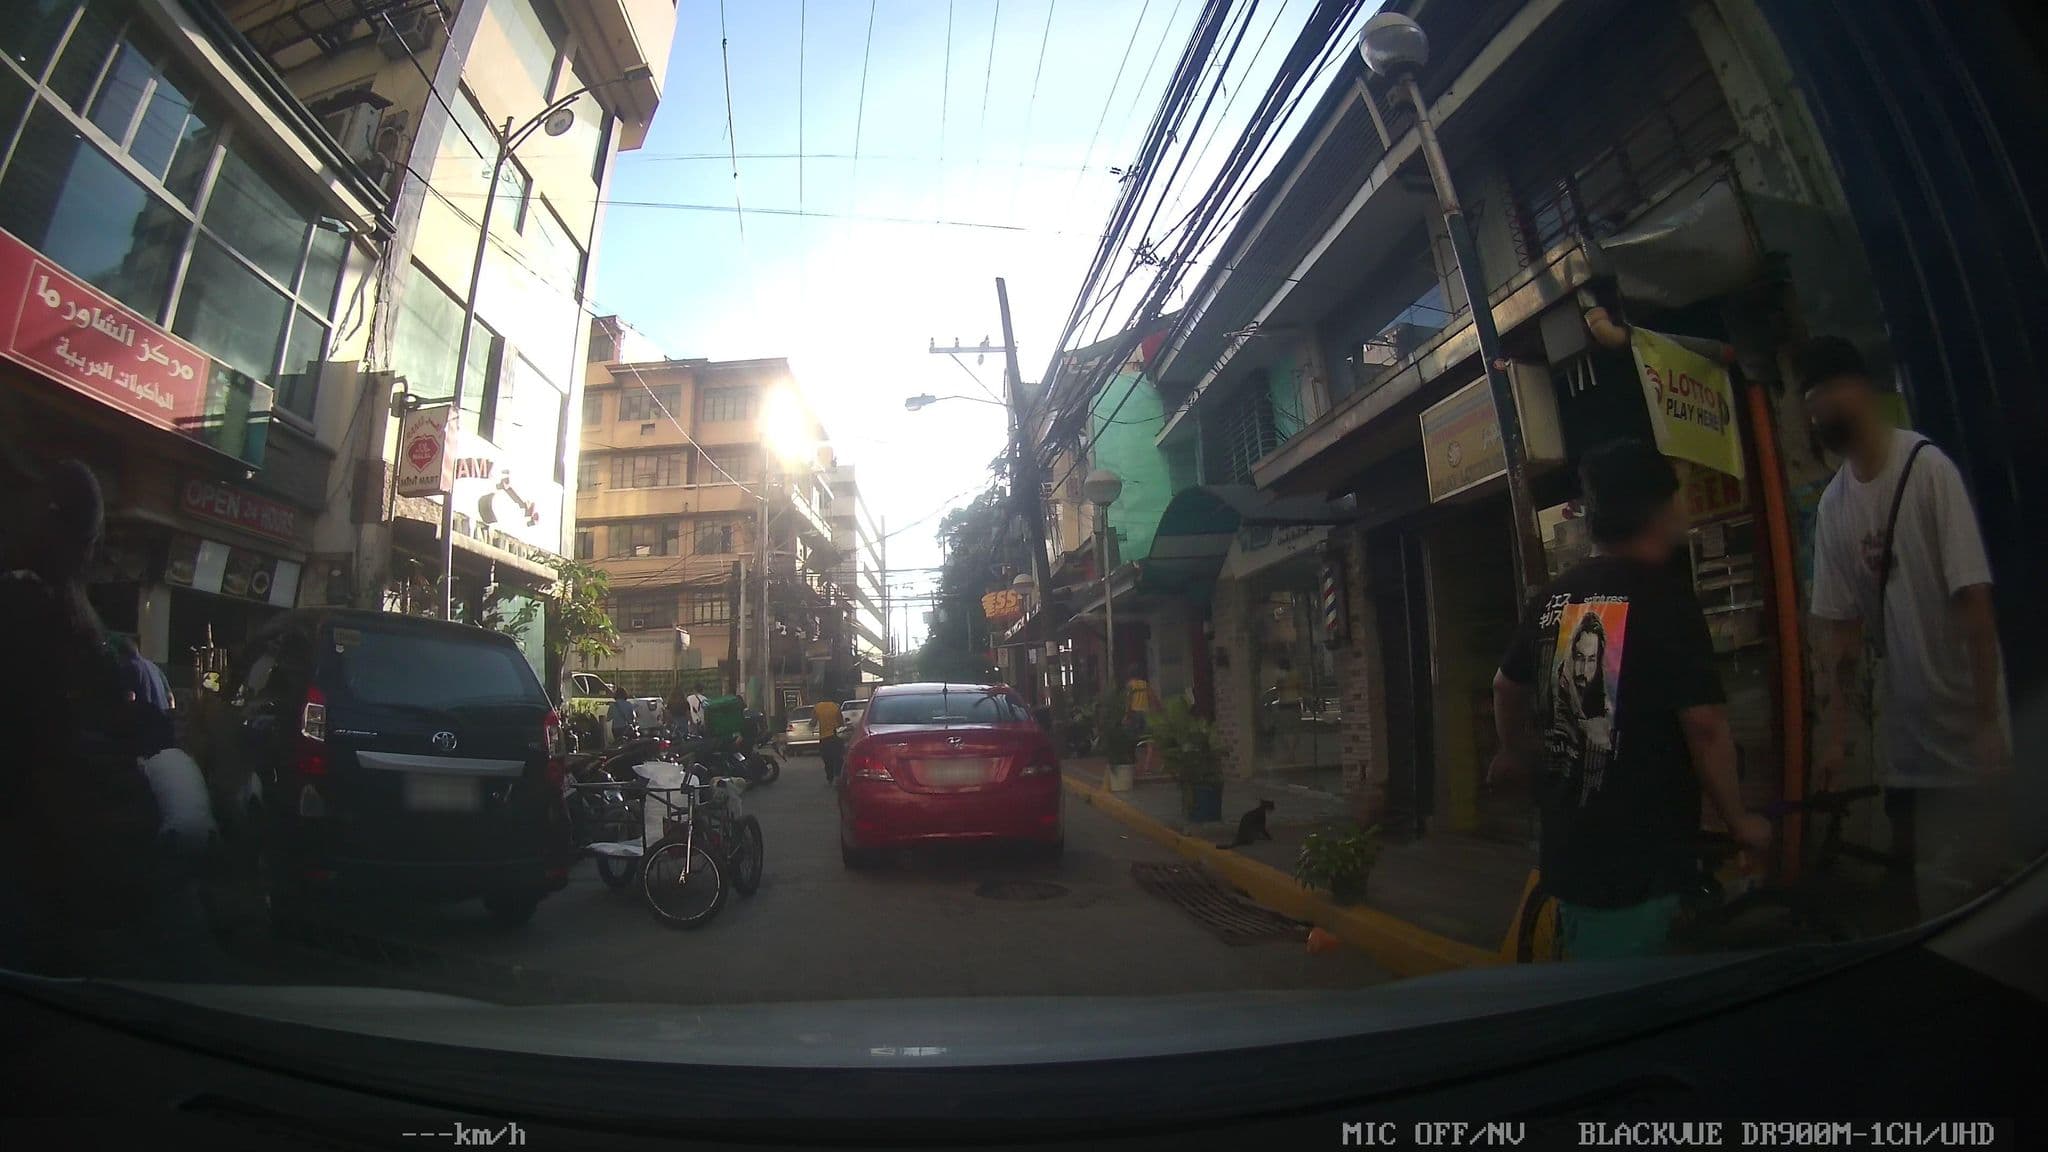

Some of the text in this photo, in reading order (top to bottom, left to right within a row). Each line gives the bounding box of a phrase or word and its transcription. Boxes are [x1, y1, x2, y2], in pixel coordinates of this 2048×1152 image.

[56, 337, 114, 381] العربية
[137, 338, 194, 380] مركز
[1666, 398, 1695, 421] PLAY
[1668, 368, 1716, 409] LOTTO
[186, 480, 241, 519] OPEN
[260, 506, 295, 537] HOURS
